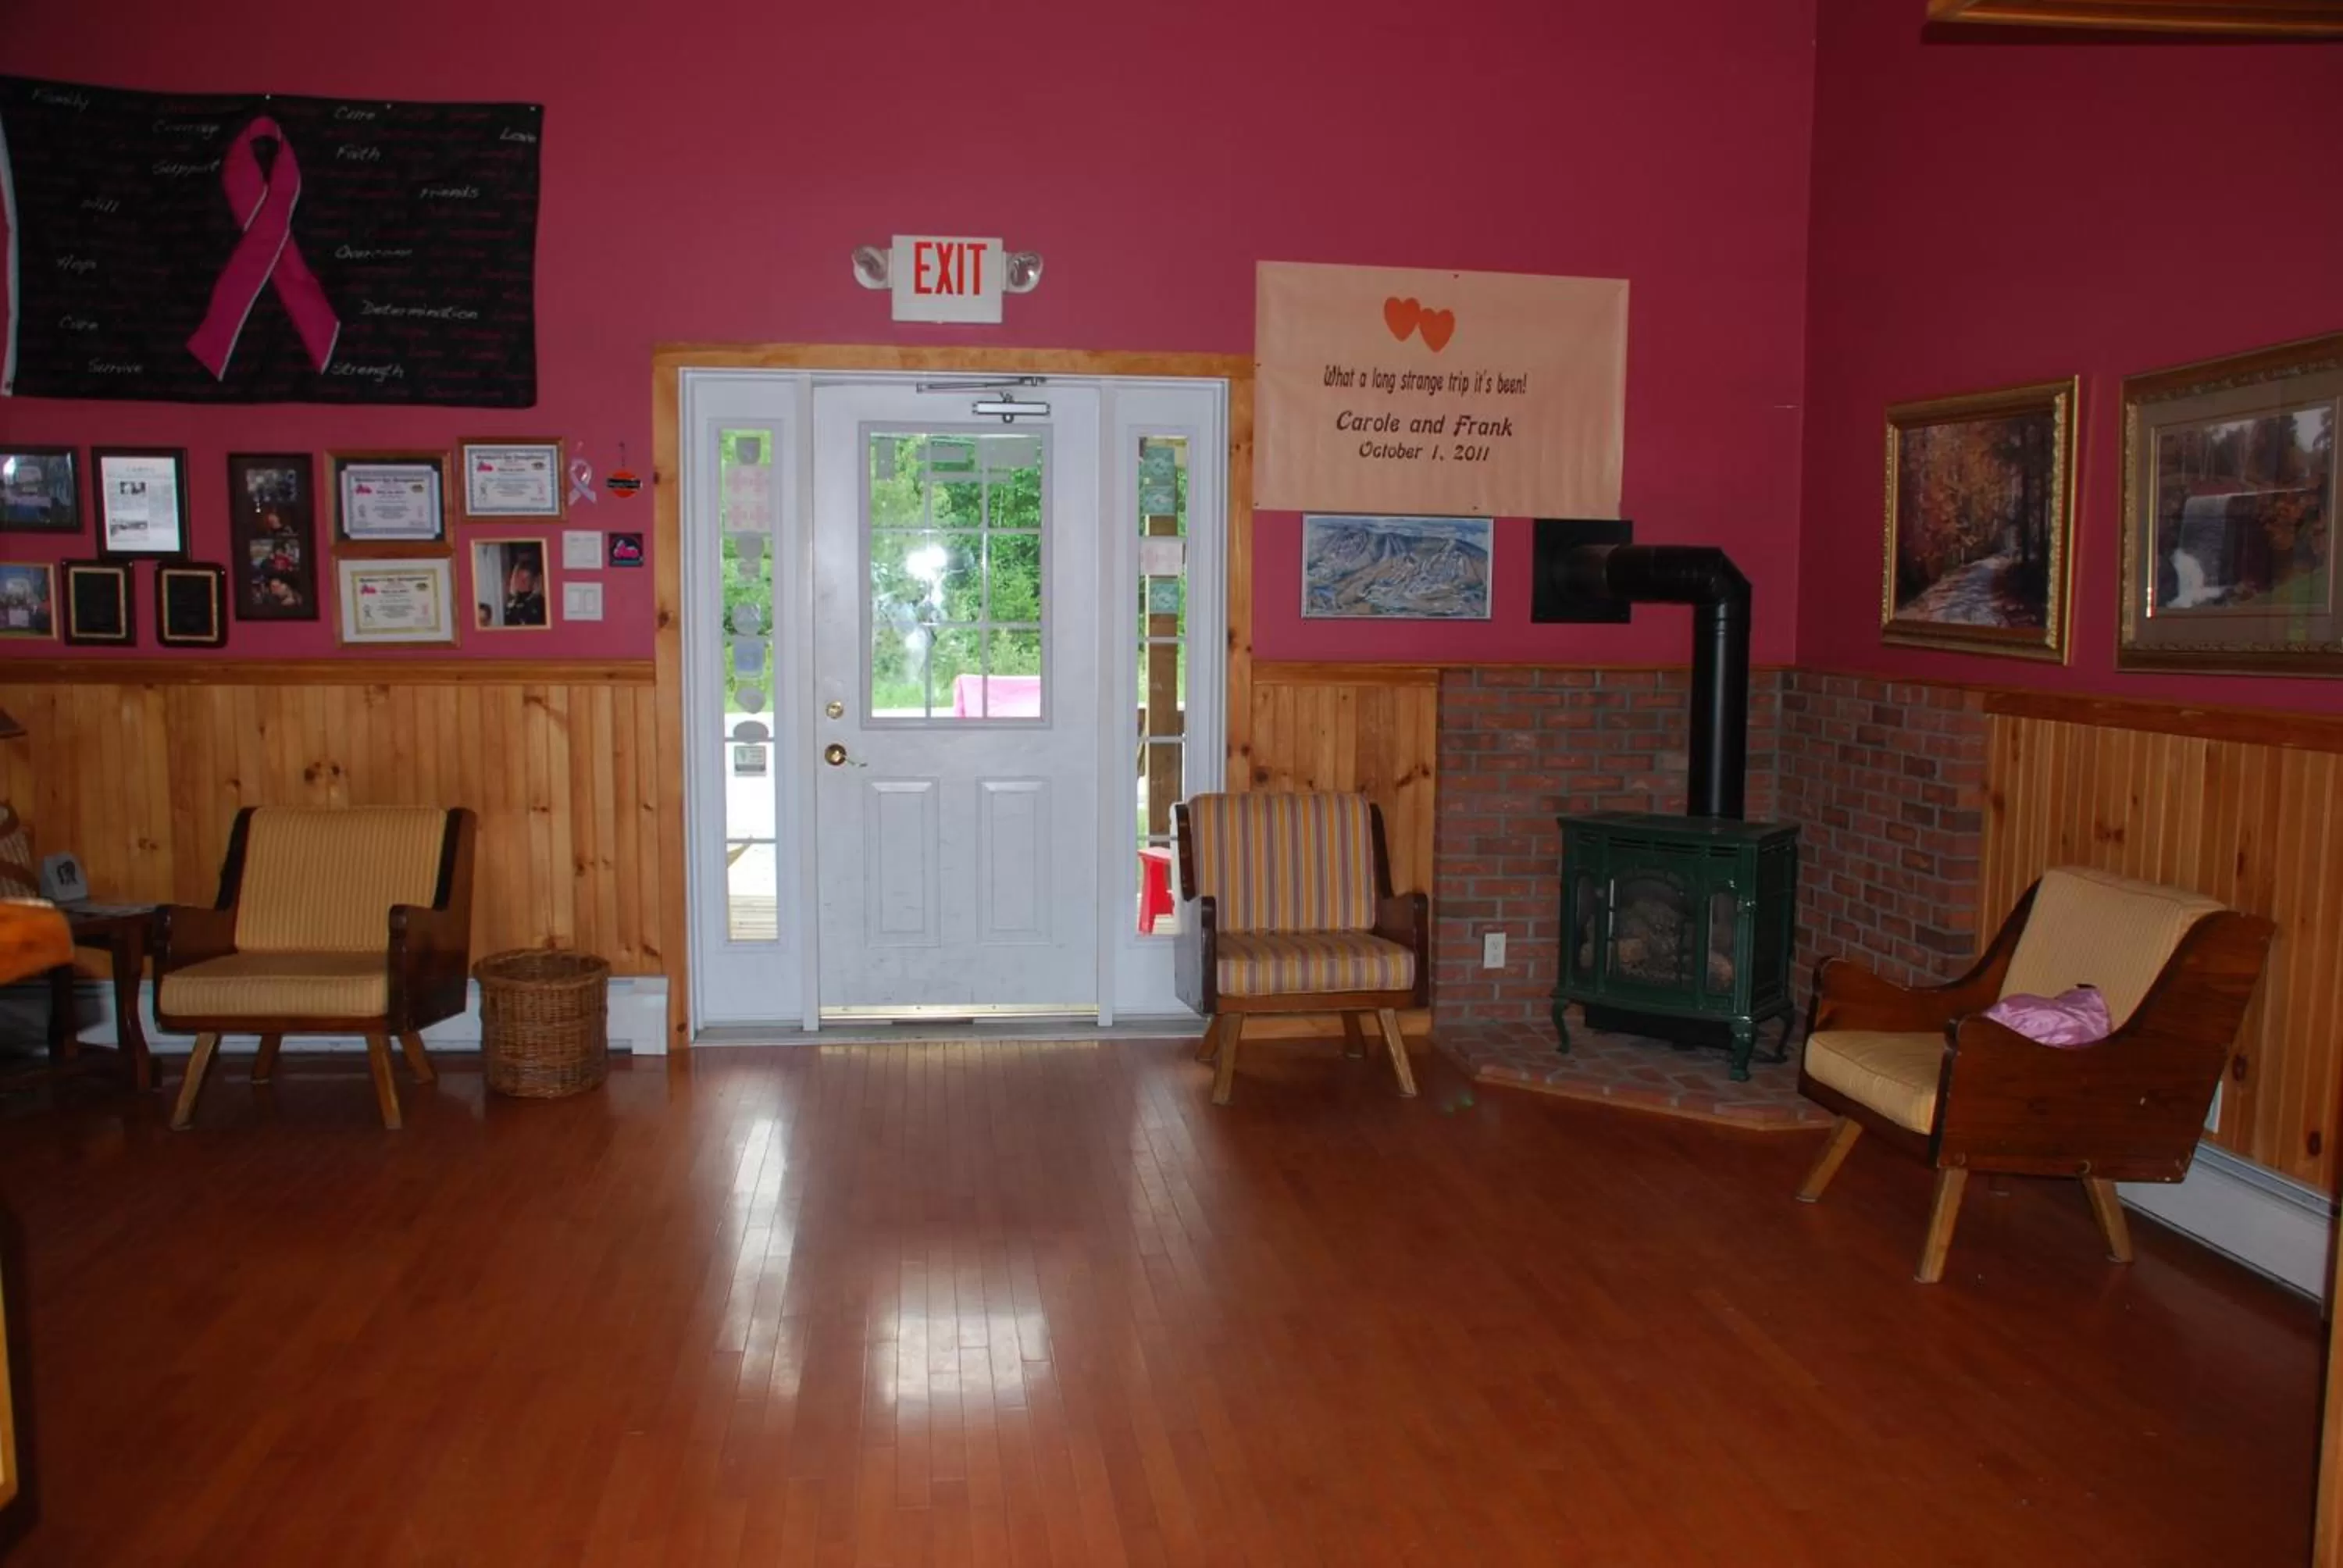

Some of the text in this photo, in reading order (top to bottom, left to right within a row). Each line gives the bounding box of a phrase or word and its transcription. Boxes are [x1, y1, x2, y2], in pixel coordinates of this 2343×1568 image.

[499, 126, 537, 143] Love
[336, 143, 381, 162] Faith
[914, 241, 988, 295] EXIT
[359, 298, 479, 321] Determination
[87, 356, 144, 376] Survive
[330, 362, 405, 383] Strength
[1324, 365, 1528, 397] What a long strange trip it's been!
[1336, 410, 1513, 437] Carole and Frank
[1358, 440, 1423, 459] October
[1453, 444, 1490, 461] 2011
